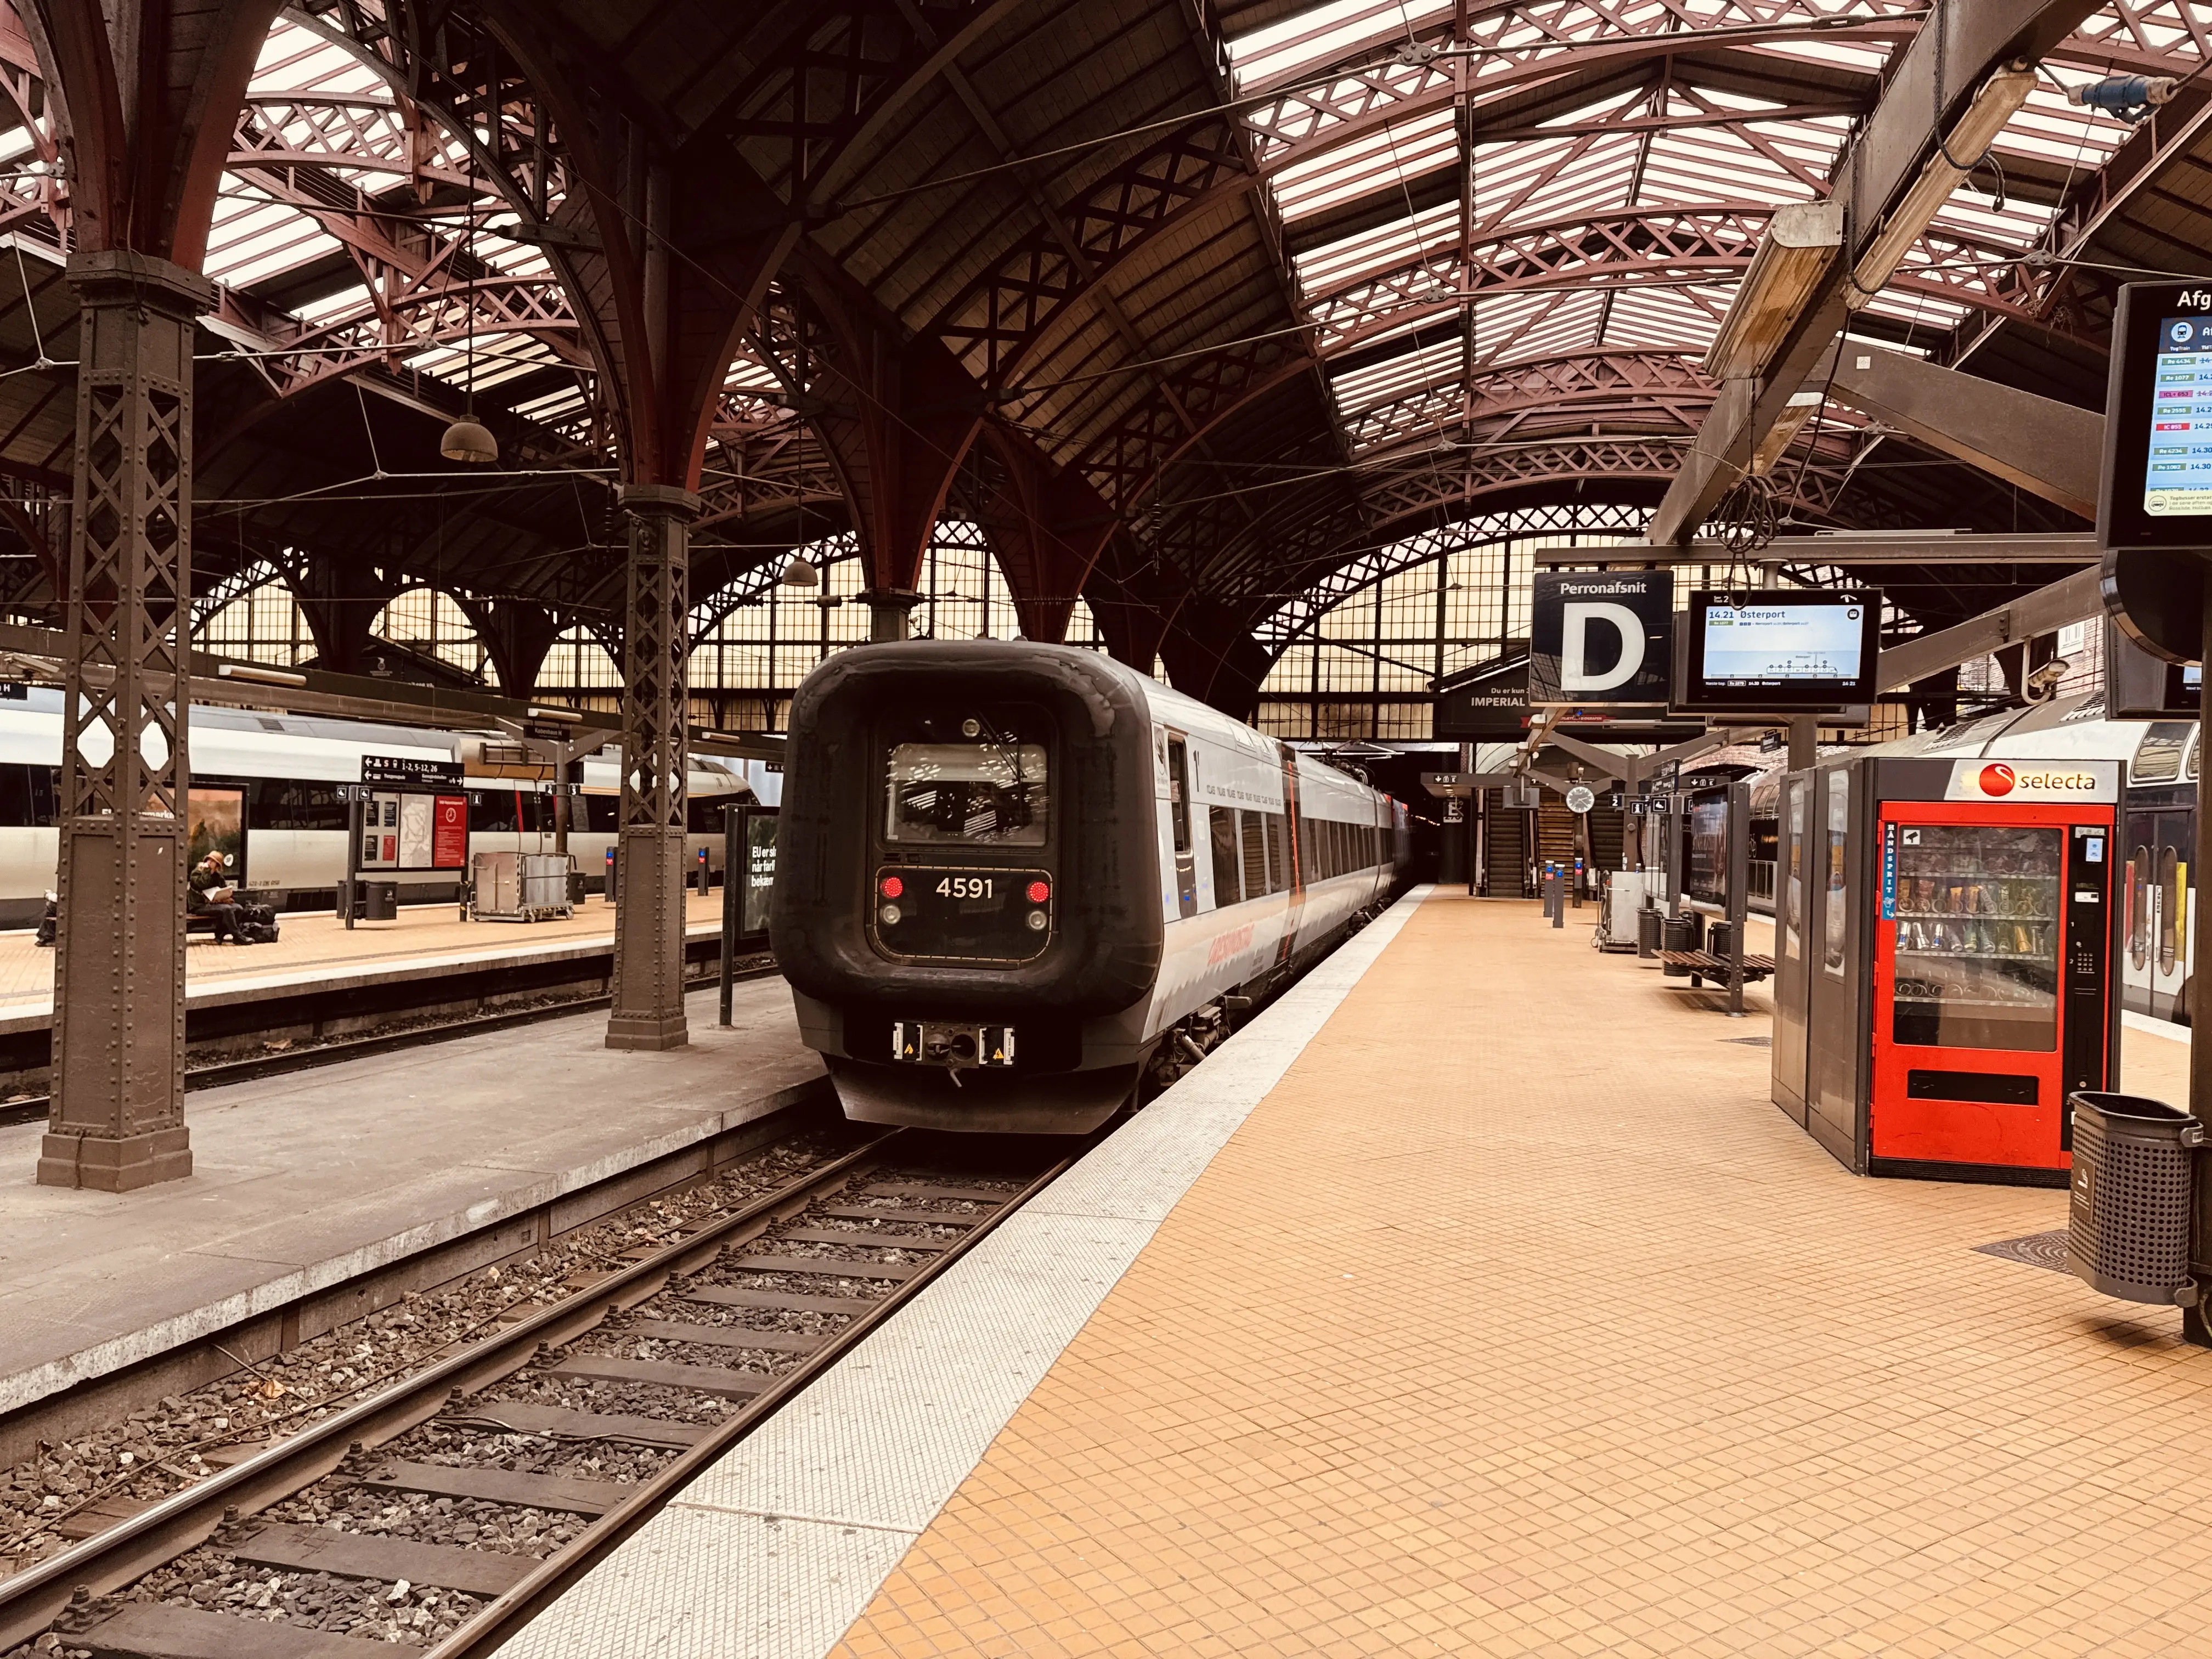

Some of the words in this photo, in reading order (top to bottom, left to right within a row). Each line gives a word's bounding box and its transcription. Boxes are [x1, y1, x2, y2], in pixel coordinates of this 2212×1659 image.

[2177, 290, 2211, 311] Afg
[1560, 581, 1647, 595] Perronafsnit
[1740, 611, 1786, 619] Østerport
[1561, 602, 1645, 691] D
[3, 684, 10, 692] H
[1471, 697, 1526, 707] IMPERIAL
[430, 764, 438, 773] 26
[2019, 773, 2096, 790] selecta
[752, 845, 761, 858] EU
[761, 848, 769, 857] er
[1886, 824, 1895, 893] HÅNDSPRIT
[752, 859, 763, 872] når
[935, 877, 992, 899] 4591
